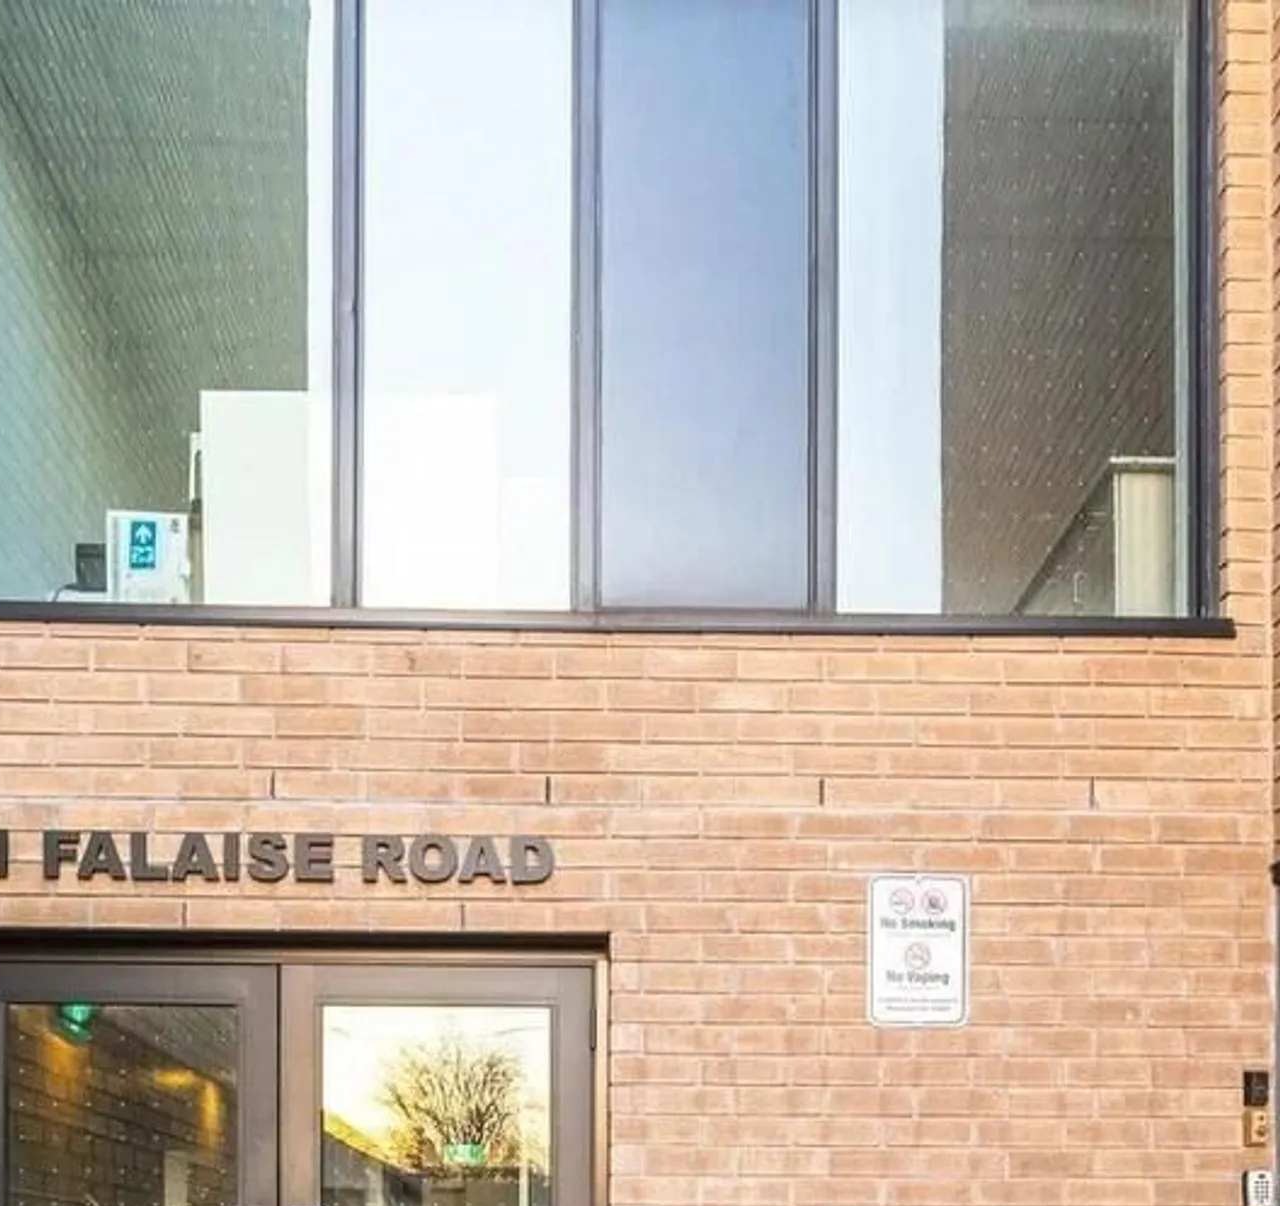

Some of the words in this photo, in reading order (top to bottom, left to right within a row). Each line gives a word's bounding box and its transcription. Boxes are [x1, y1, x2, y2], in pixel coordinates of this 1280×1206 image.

[42, 830, 336, 883] FALAISE
[361, 833, 556, 885] ROAD
[880, 917, 897, 929] No
[901, 917, 956, 932] Smoking
[886, 970, 903, 982] No
[907, 970, 950, 985] Vaping
